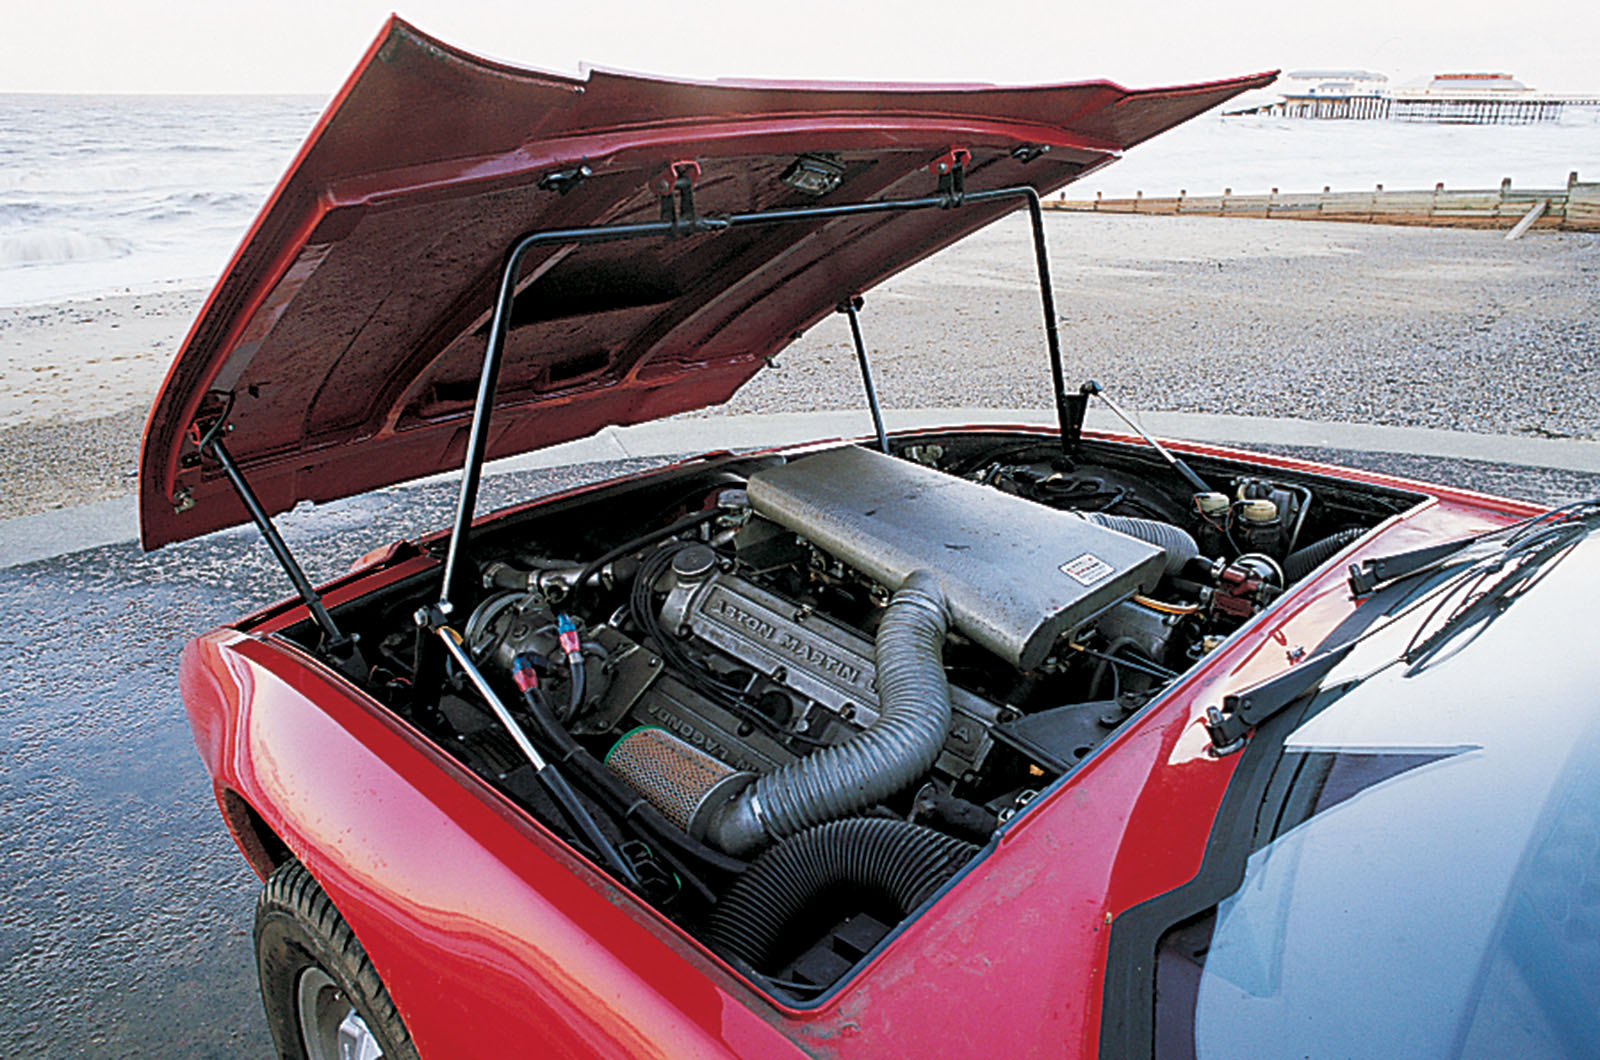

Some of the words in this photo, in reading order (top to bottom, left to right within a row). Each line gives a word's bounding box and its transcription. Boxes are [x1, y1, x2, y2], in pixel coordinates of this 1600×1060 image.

[711, 600, 776, 640] ASTON
[780, 632, 860, 686] MARTIN
[648, 702, 729, 760] LAGONDA
